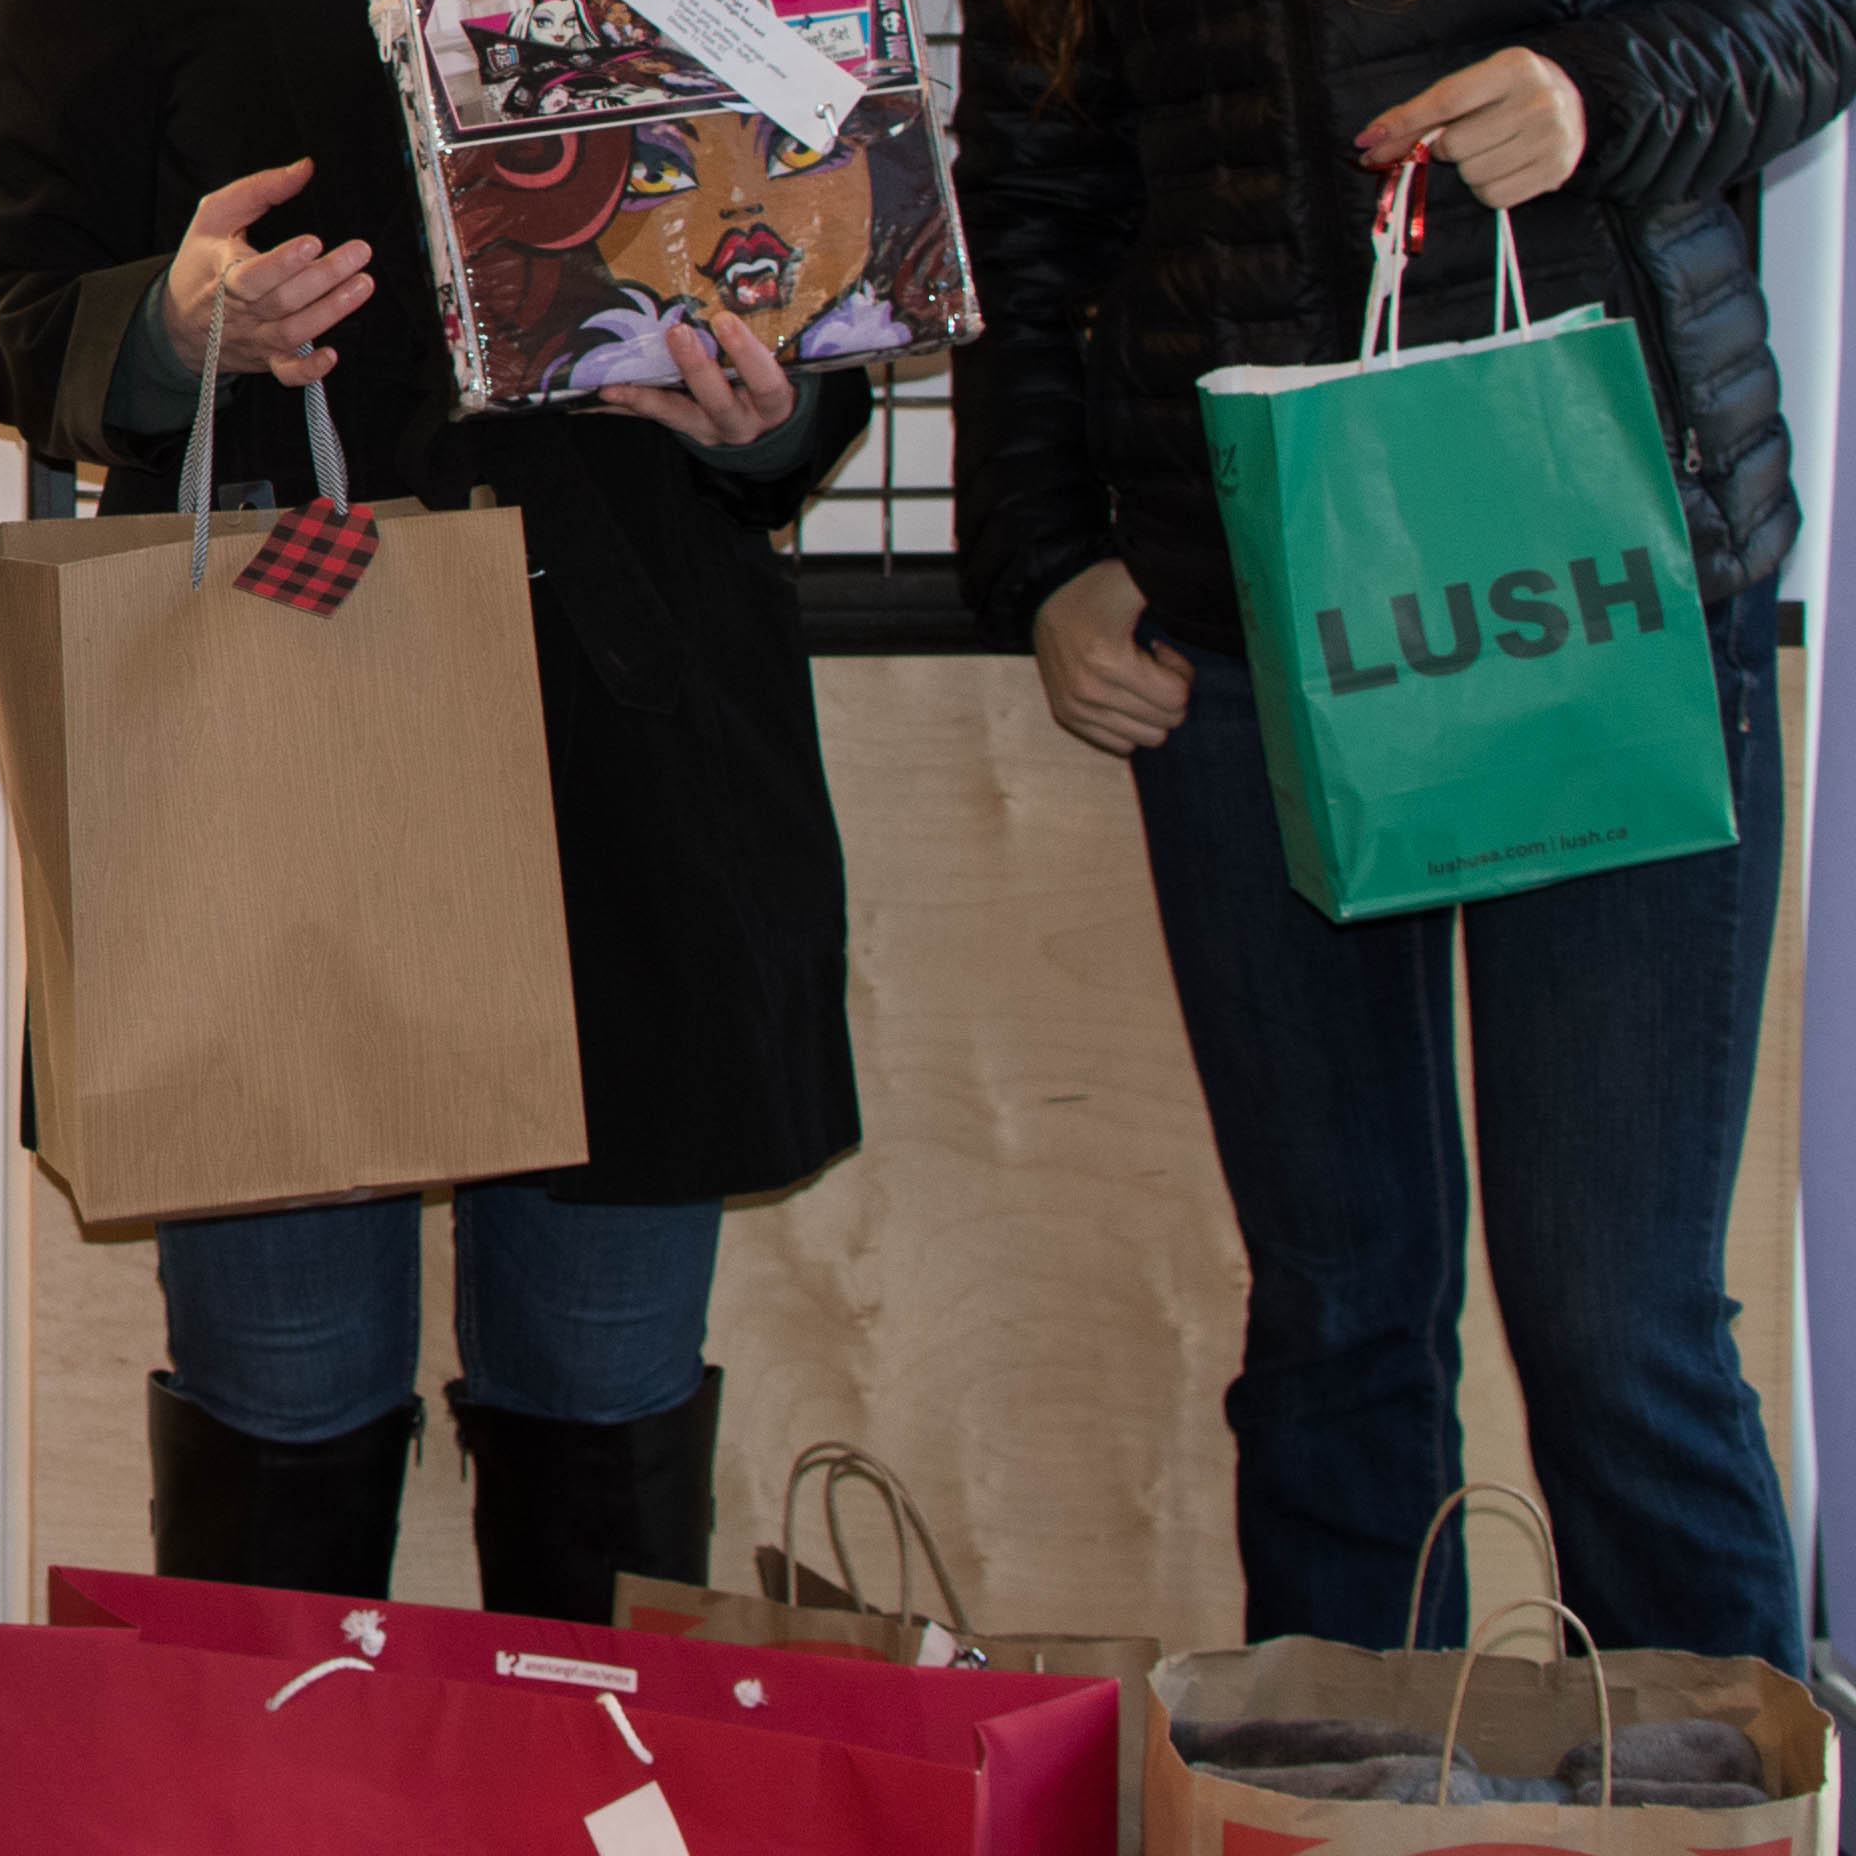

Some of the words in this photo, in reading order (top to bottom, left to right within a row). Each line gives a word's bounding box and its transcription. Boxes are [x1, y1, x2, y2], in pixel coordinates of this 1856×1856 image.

[1315, 546, 1665, 698] LUSH
[1427, 841, 1545, 876] lushusa.com
[1560, 826, 1628, 852] lush.ca
